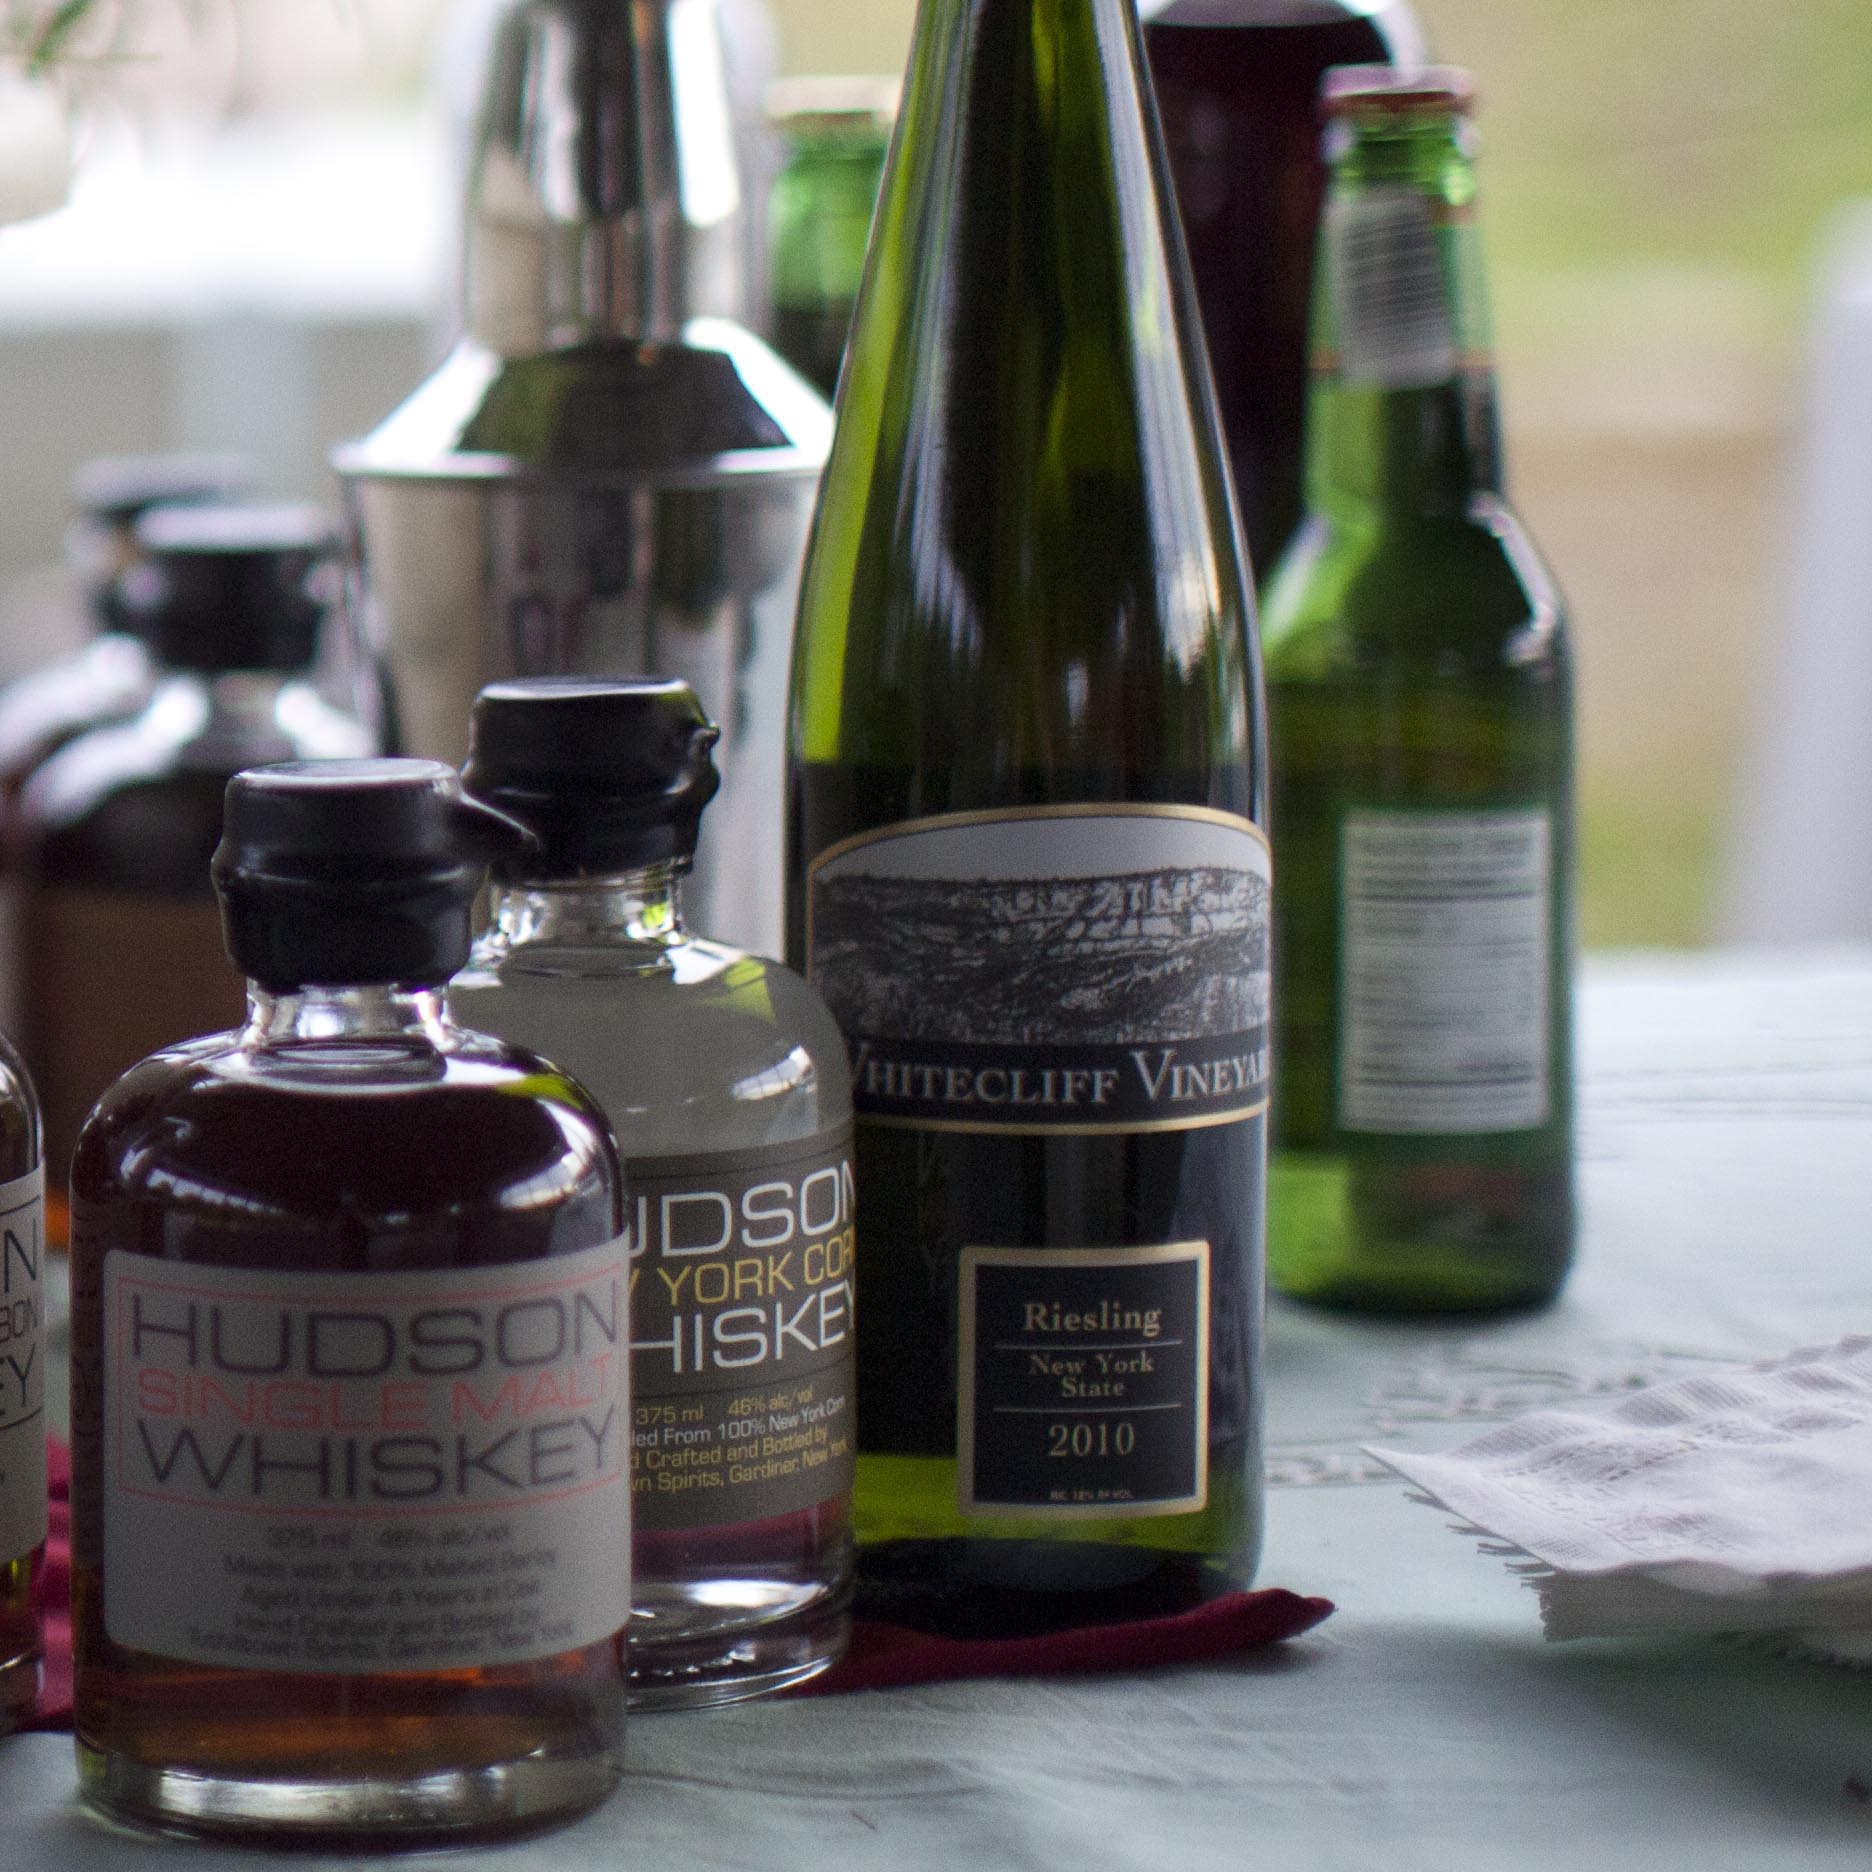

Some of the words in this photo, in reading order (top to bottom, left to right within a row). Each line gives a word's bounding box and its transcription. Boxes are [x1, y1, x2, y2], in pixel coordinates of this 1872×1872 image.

[656, 1250, 794, 1307] YORK
[131, 1279, 618, 1377] HUDSON
[1023, 1301, 1163, 1338] Riesling
[1029, 1354, 1085, 1376] New
[1096, 1350, 1154, 1374] York
[137, 1366, 428, 1428] SINGLE
[455, 1353, 613, 1422] MALT
[1060, 1378, 1125, 1399] State
[635, 1406, 676, 1425] 375
[682, 1404, 704, 1422] ml
[727, 1397, 766, 1416] 46%
[664, 1427, 712, 1444] From
[717, 1420, 766, 1440] 100%
[769, 1413, 800, 1432] New
[136, 1404, 615, 1499] WHISKEY
[646, 1447, 722, 1470] Crafted
[727, 1443, 759, 1462] and
[1048, 1422, 1136, 1457] 2010
